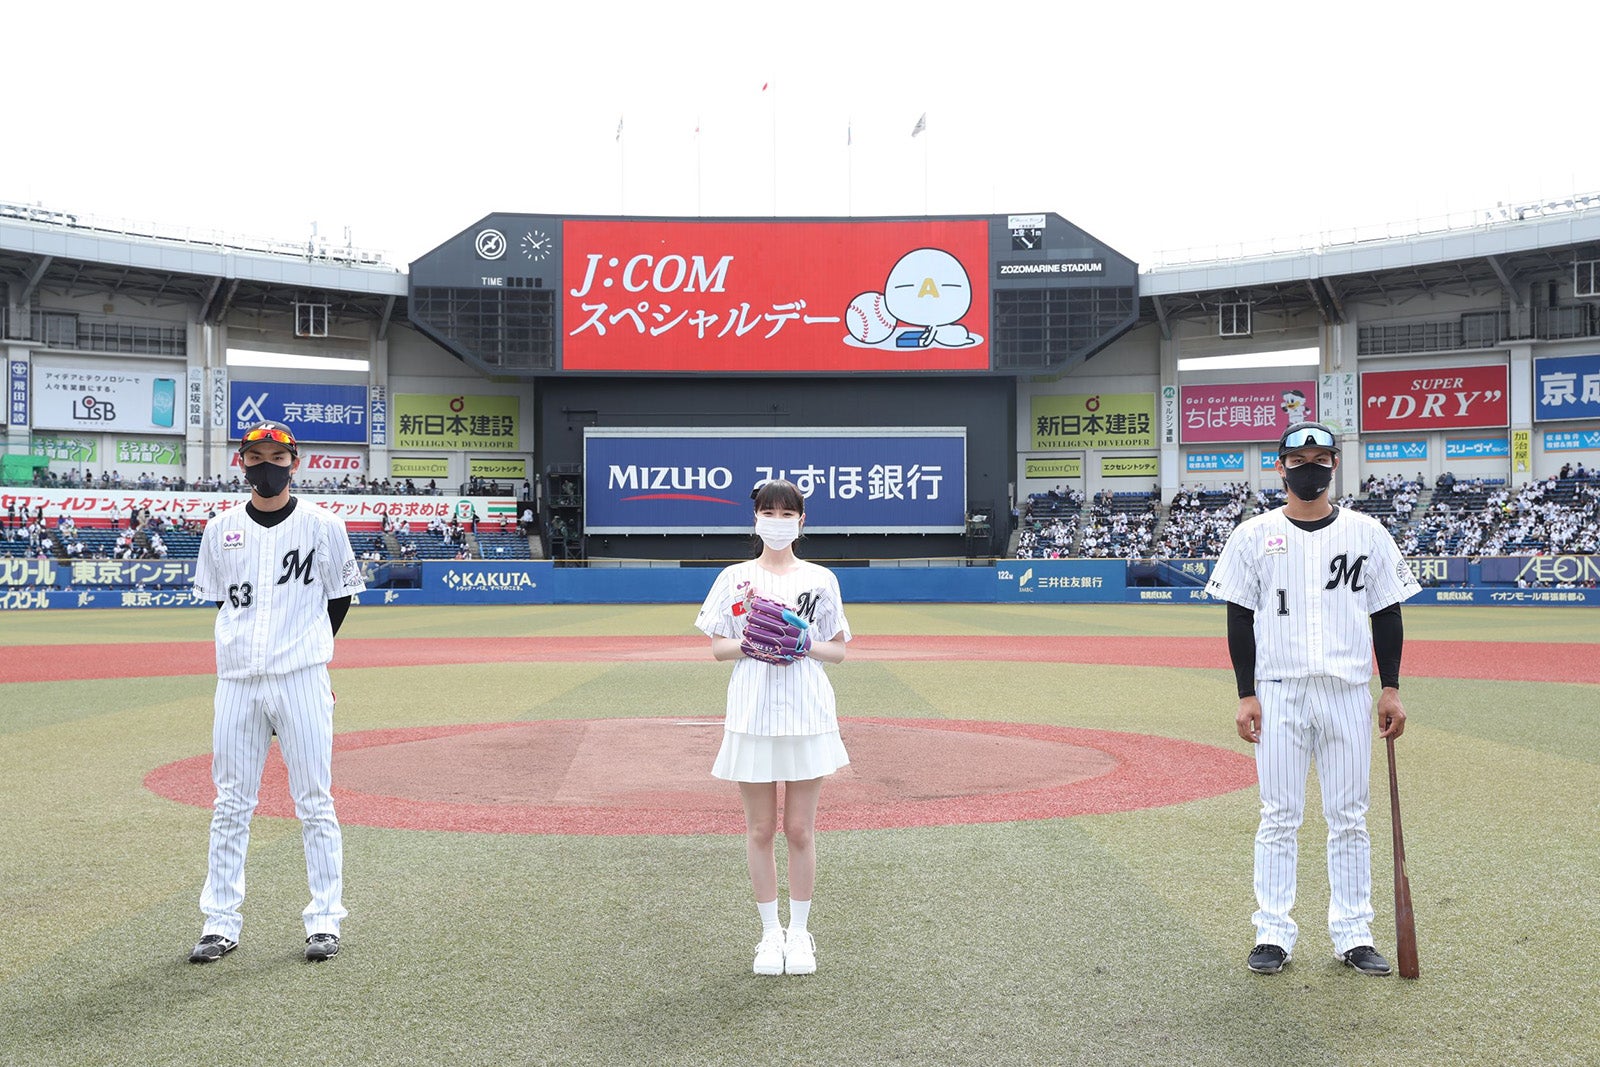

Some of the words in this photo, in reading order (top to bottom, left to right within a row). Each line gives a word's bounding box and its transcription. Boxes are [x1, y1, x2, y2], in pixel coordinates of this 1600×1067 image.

[570, 254, 734, 297] J:COM
[1001, 263, 1059, 274] ZOZOMARINE
[1061, 262, 1102, 273] STADIUM
[481, 277, 503, 287] TIME
[570, 301, 841, 340] スペシャルデー
[1411, 377, 1464, 391] SUPER
[1186, 396, 1203, 404] Go!
[1207, 396, 1225, 404] Go!
[1230, 395, 1276, 403] Marines!
[282, 402, 365, 425] 京葉銀行
[1185, 405, 1277, 429] ちば興銀
[399, 414, 514, 438] 新日本建設
[1036, 412, 1150, 437] 新日本建設
[119, 441, 160, 453] そらまめ
[400, 440, 459, 448] INTELLIGENT
[461, 441, 514, 449] DEVELOPER
[1038, 440, 1093, 448] INTELLIGENT
[1097, 439, 1150, 447] DEVELOPER
[472, 464, 525, 473] エクセレントシティ
[1104, 463, 1156, 471] エクセレントシティ
[608, 464, 733, 490] MIZUHO
[277, 548, 316, 585] M
[1325, 553, 1369, 592] M
[462, 571, 532, 587] KAKUTA
[1038, 576, 1103, 588] 三井住友銀行
[228, 582, 253, 609] 63
[1276, 588, 1290, 616] 1
[1490, 592, 1586, 602] イオンモール幕張新都心
[797, 591, 820, 624] M
